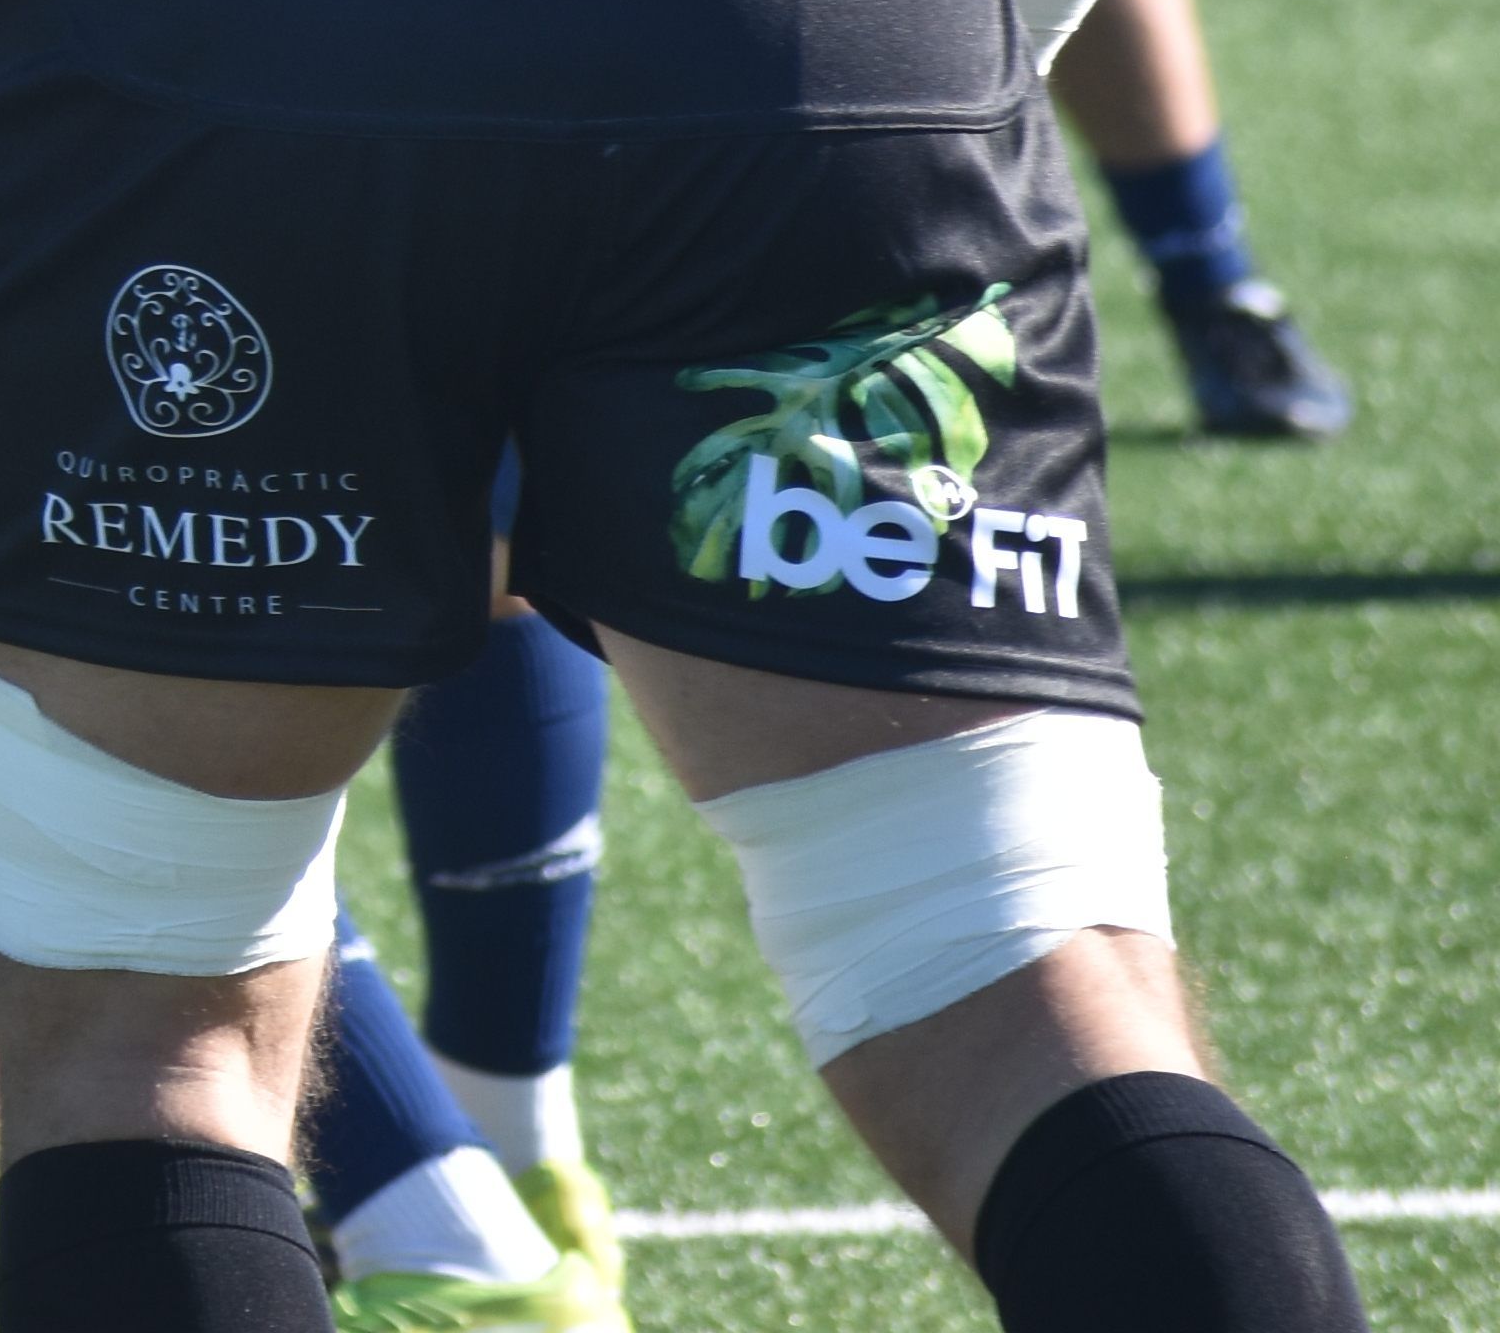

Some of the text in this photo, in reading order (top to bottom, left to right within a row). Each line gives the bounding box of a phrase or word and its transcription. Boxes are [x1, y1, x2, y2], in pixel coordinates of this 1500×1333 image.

[42, 492, 376, 568] REMEDY
[739, 453, 940, 603] be
[128, 586, 284, 615] CENTRE
